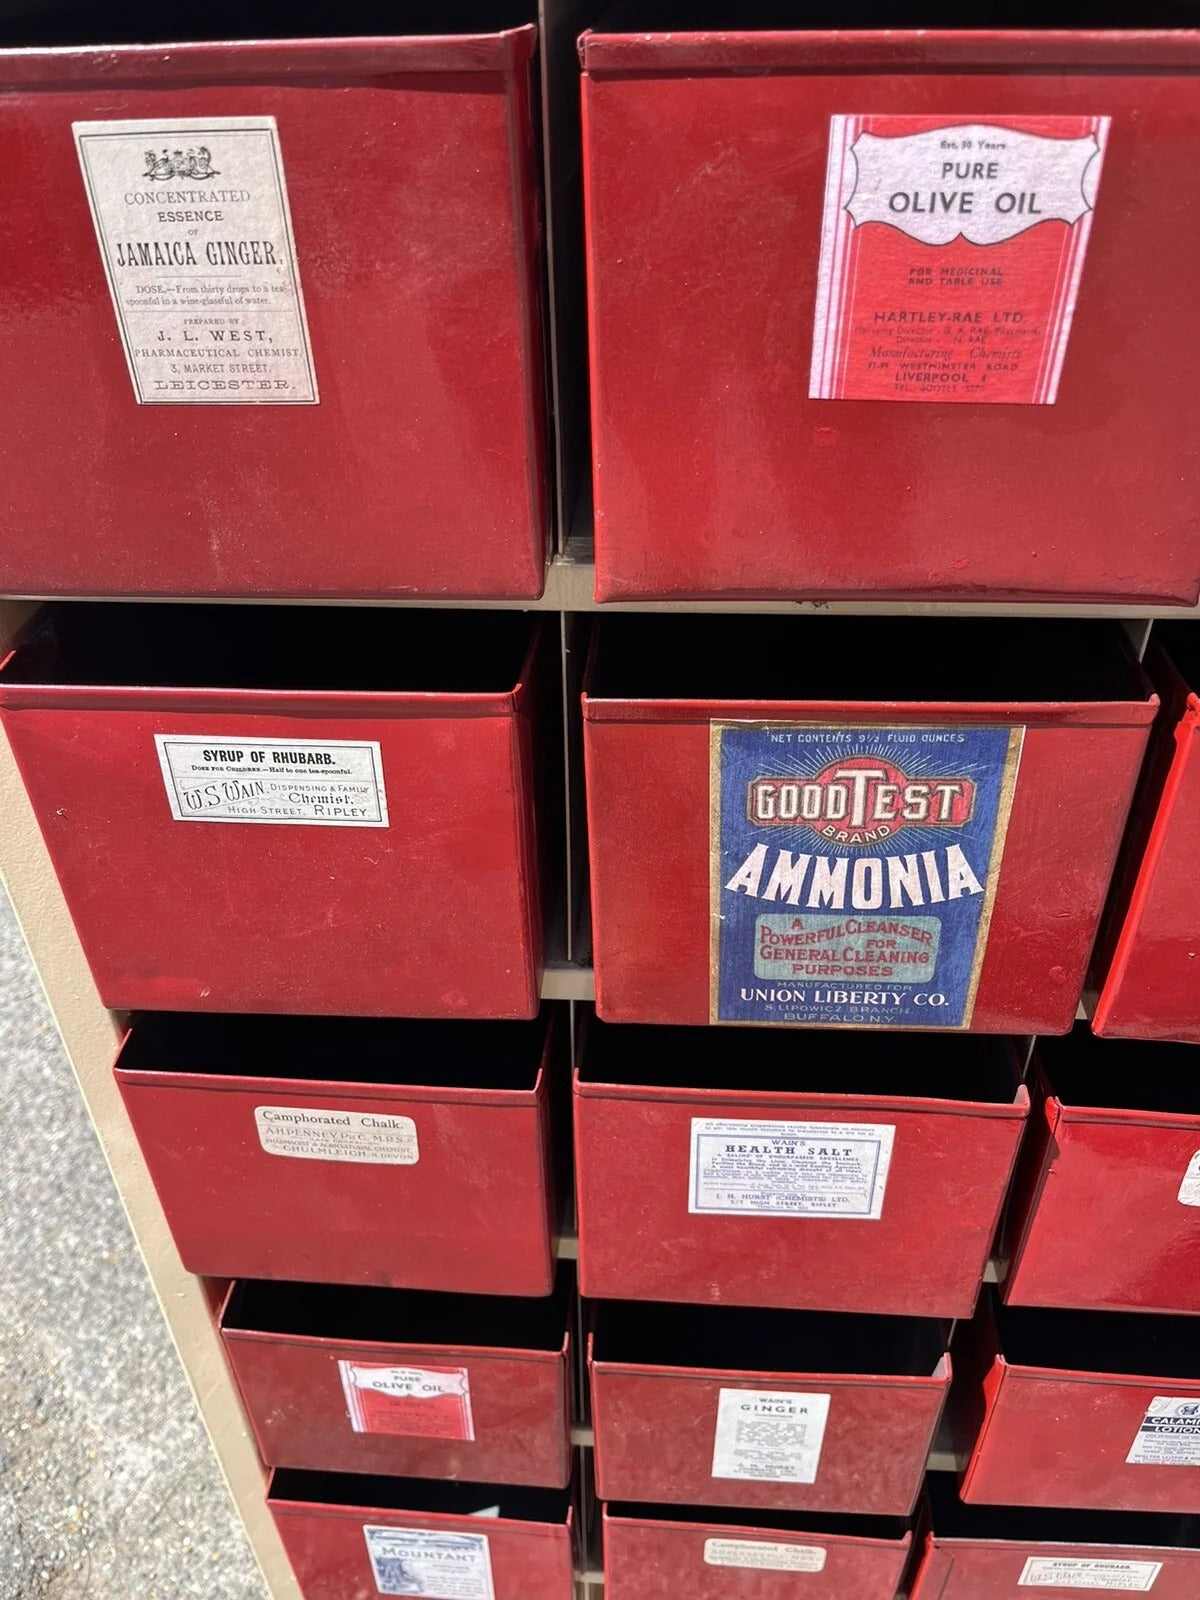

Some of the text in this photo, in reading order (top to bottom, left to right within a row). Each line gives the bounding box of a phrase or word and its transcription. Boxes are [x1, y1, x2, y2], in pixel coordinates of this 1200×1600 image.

[977, 140, 1007, 150] Years
[941, 162, 999, 179] PURE
[124, 190, 250, 205] CONCENTRATED
[889, 191, 1043, 215] OLIVE OIL
[158, 211, 224, 223] ESSENCE
[117, 242, 197, 267] JAMAICA
[909, 268, 1003, 276] FOR MEDICINAL
[908, 277, 933, 285] AND
[981, 278, 1002, 286] USE
[200, 284, 224, 297] thirty
[226, 285, 250, 297] drops
[252, 286, 262, 294] to
[263, 286, 270, 294] a
[126, 297, 160, 307] spoonful
[162, 297, 170, 305] in
[235, 296, 244, 305] of
[157, 330, 273, 343] J. L. WEST,
[135, 349, 240, 358] PHARMACEUTICAL
[183, 364, 225, 374] MARKET
[900, 362, 1018, 371] WESTMINSTER ROAD
[895, 372, 968, 382] LIVERPOOL
[153, 380, 296, 391] LEICESTER.
[771, 734, 792, 743] NET
[798, 733, 851, 743] CONTENTS
[887, 735, 916, 743] FLUID
[921, 734, 965, 743] OUNCES
[203, 750, 336, 765] SYRUP OF RHUBARB.
[270, 783, 327, 792] DISPENSING
[338, 785, 369, 793] FAMILY
[228, 806, 256, 814] HIGH
[821, 825, 891, 844] BRAND
[725, 843, 985, 910] AMMONIA
[792, 917, 804, 930] A
[760, 919, 933, 947] POWERFUL CLEANSER
[866, 939, 897, 949] FOR
[760, 945, 930, 964] GENERAL CLEANING
[792, 963, 894, 977] PURPOSES
[777, 981, 882, 991] MANUFACTURED
[740, 988, 949, 1007] UNION LIBERTY CO.
[784, 1013, 865, 1021] BUFFALO
[262, 1111, 404, 1130] Camphorated Chalk.
[725, 1145, 852, 1156] HEALTH SALT
[372, 1381, 413, 1391] OLIVE
[741, 1404, 808, 1414] GINGER
